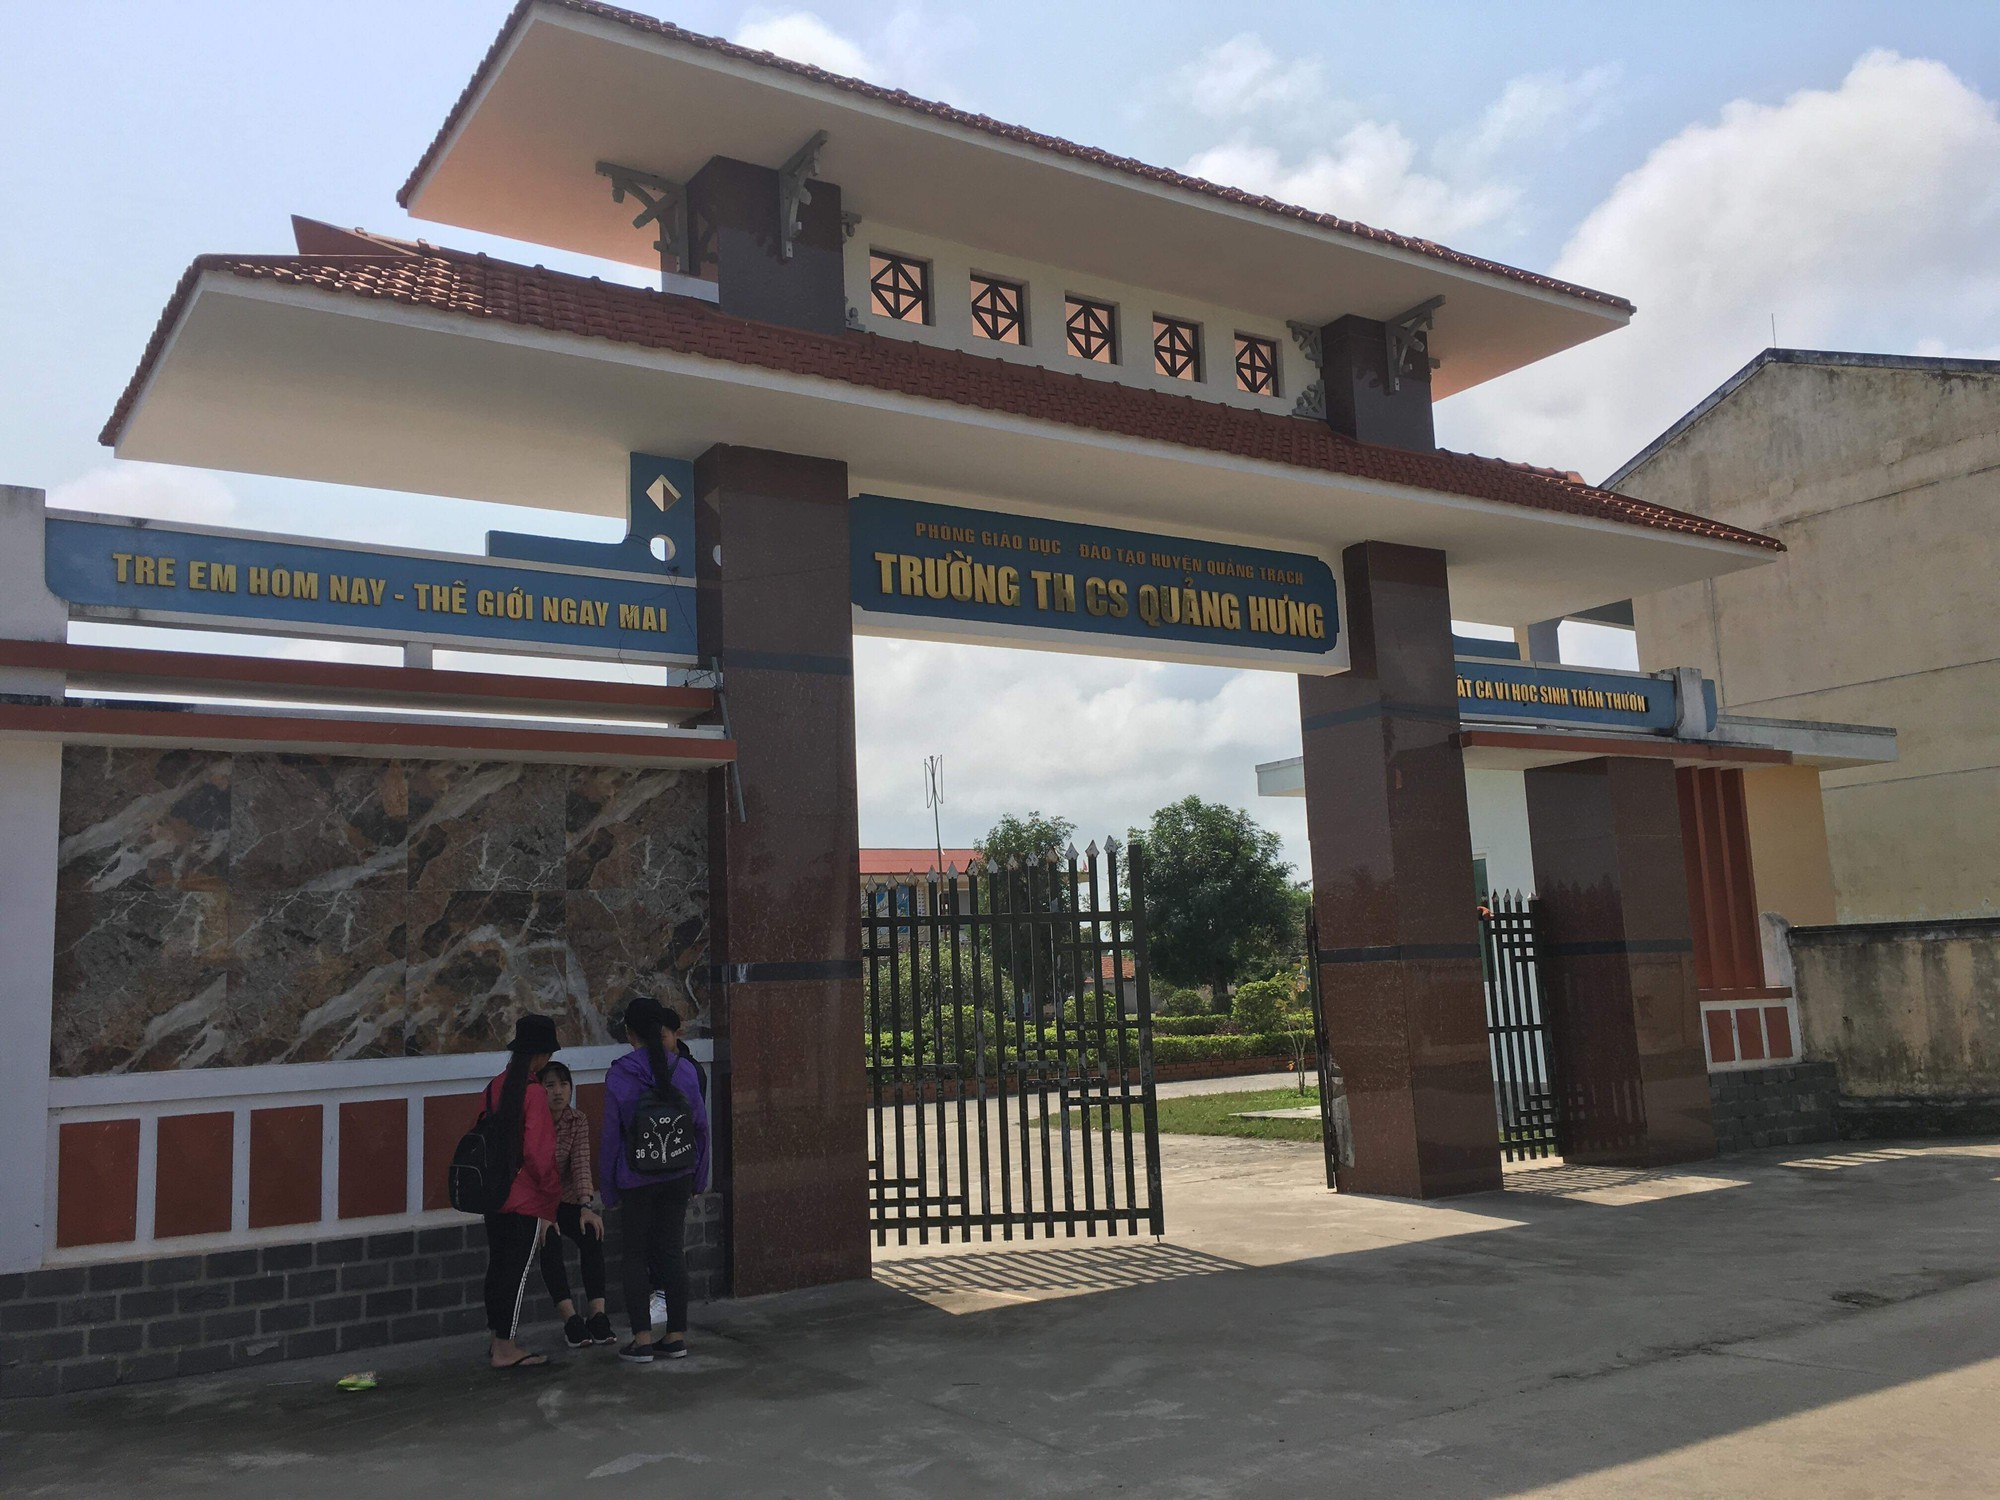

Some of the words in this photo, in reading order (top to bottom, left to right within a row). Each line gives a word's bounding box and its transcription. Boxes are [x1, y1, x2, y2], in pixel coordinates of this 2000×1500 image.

[113, 552, 176, 587] TRE
[189, 560, 237, 593] EM
[329, 575, 386, 606] NAY
[542, 596, 609, 627] NGAY
[619, 604, 667, 632] MAI
[874, 549, 1020, 606] TRƯỜNG
[1139, 577, 1241, 631] QUẢNG
[1248, 594, 1325, 639] HƯNG
[1539, 685, 1569, 705] SINH
[1570, 686, 1604, 709] THÂN
[635, 1148, 646, 1159] 36
